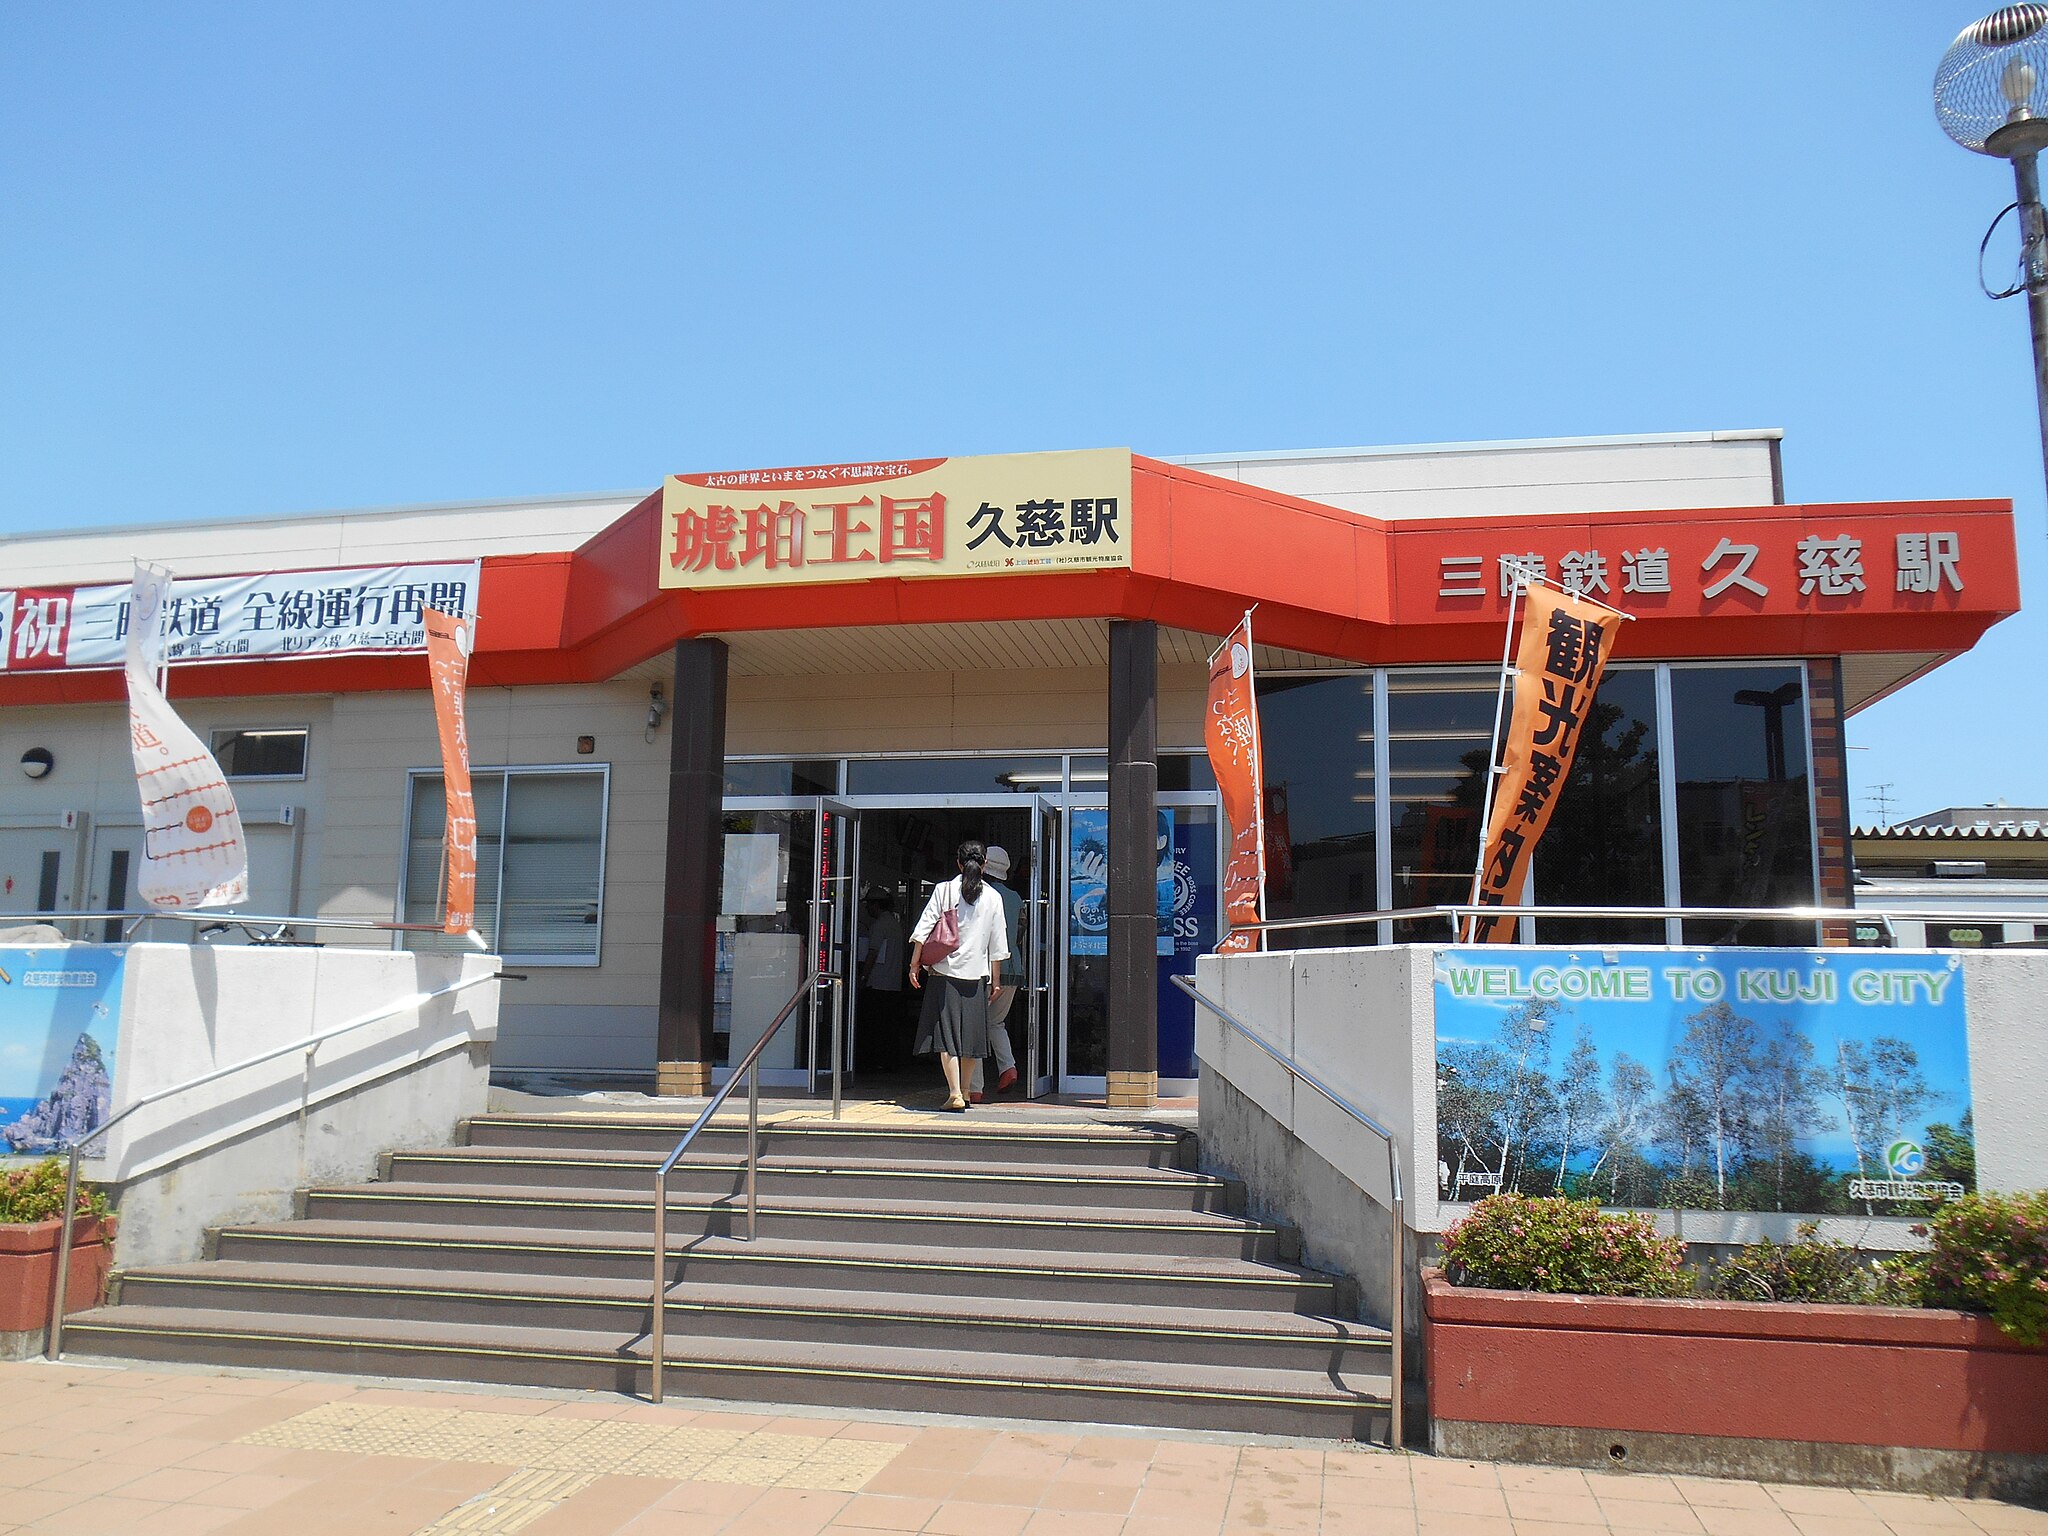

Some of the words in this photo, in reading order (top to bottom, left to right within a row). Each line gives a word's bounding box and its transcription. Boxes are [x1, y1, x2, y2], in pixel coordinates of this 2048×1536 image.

[705, 464, 913, 487] 太古の世界といまをつなぐ不思議な宝石。
[670, 491, 947, 573] 琥珀王国
[966, 497, 1119, 551] 久慈駅
[1439, 547, 1672, 597] 三陸鉄道
[1700, 532, 1965, 599] 久慈駅
[240, 582, 467, 632] 全線運行再開
[15, 597, 68, 660] 祝
[1173, 860, 1191, 876] EE
[1186, 875, 1197, 893] BOSS
[1180, 894, 1196, 916] COFFEE
[1448, 967, 1649, 998] WELCOME
[1666, 969, 1723, 1000] TO
[1740, 971, 1834, 1001] KUJI
[1852, 971, 1951, 1002] CITY
